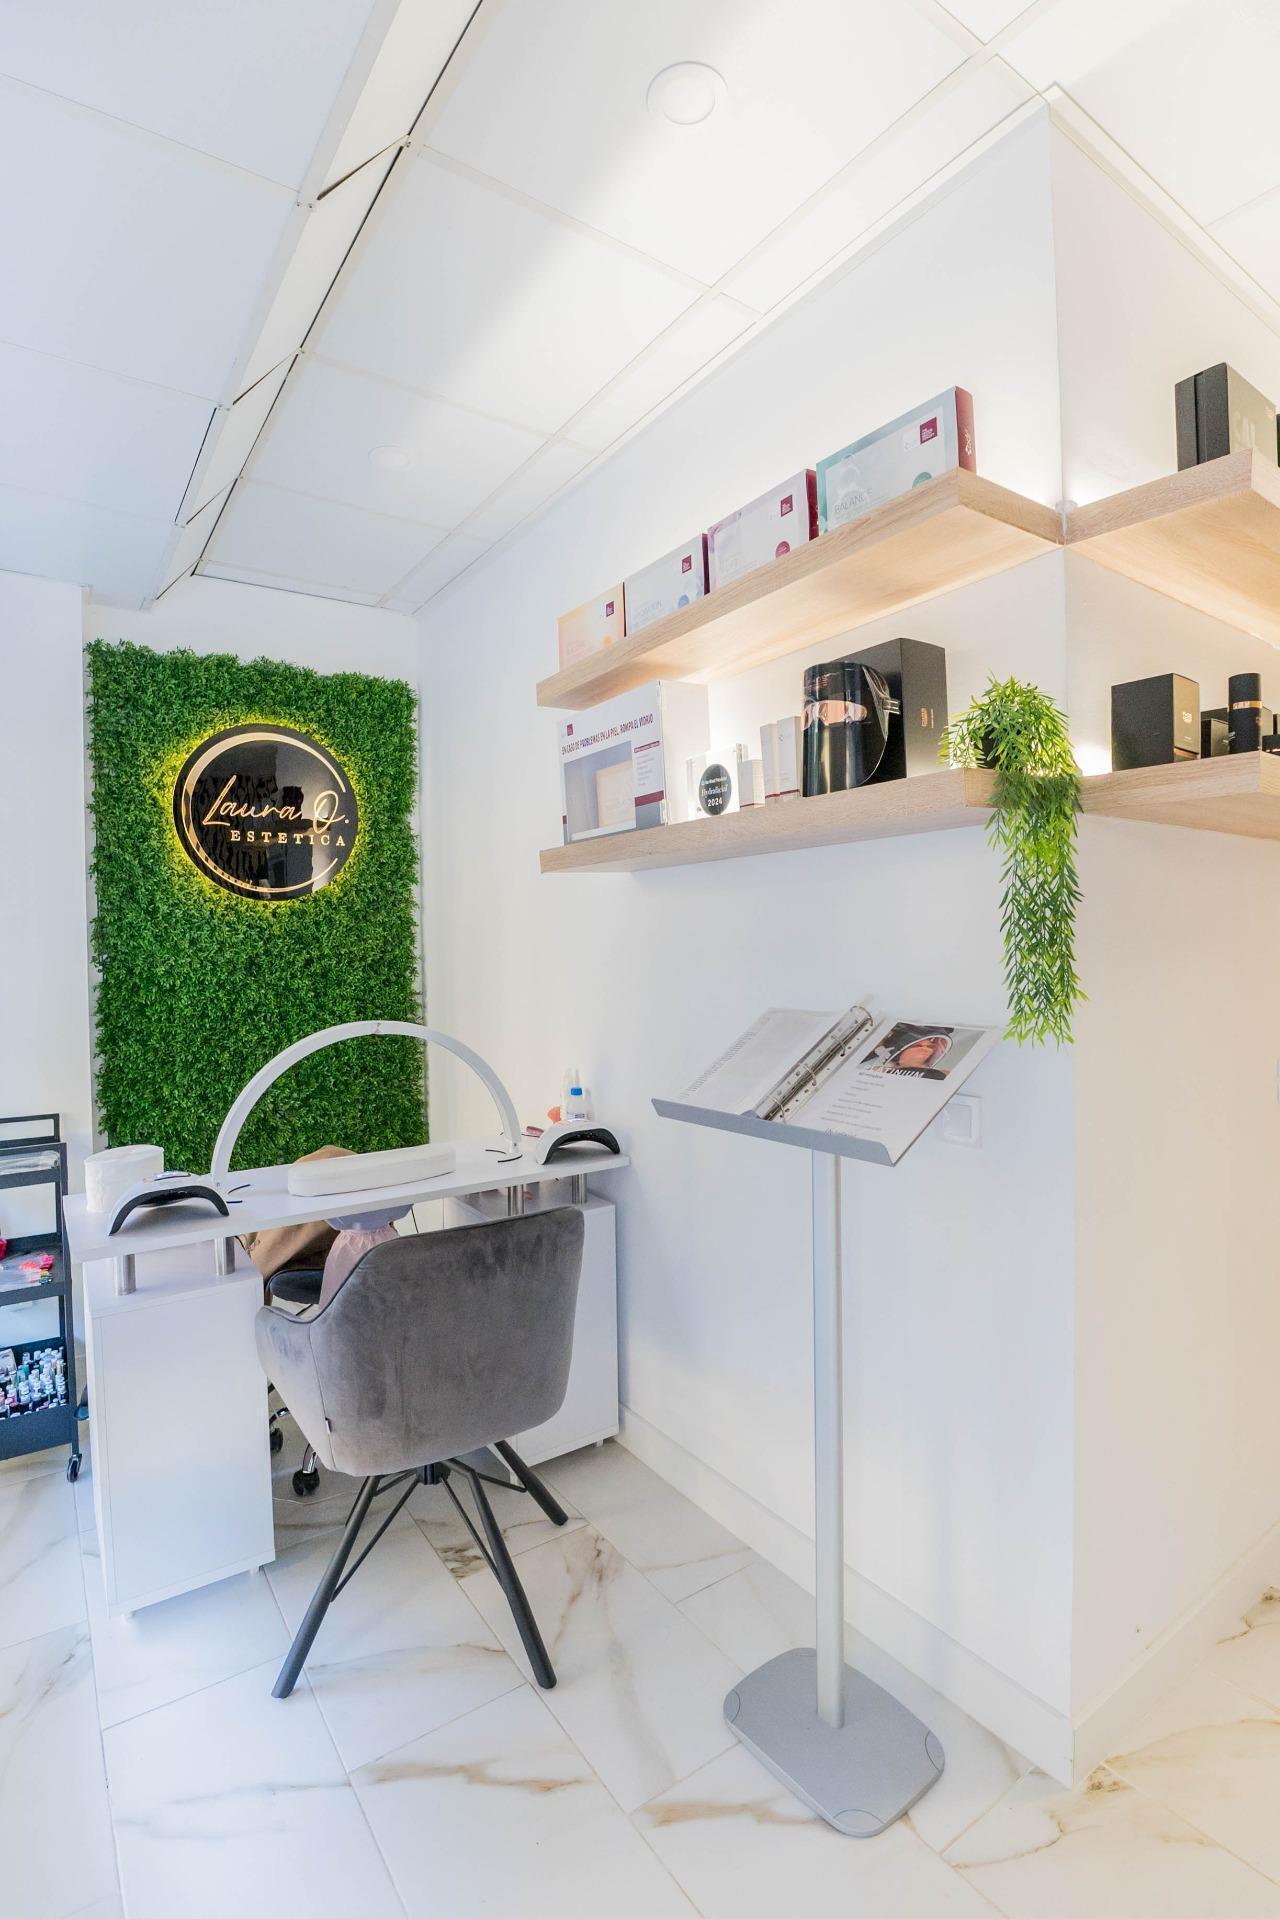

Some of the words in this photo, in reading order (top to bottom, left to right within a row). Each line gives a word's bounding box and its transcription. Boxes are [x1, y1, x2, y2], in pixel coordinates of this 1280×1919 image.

[202, 774, 302, 826] Laura
[708, 797, 723, 807] 2024
[230, 830, 346, 847] ESTETICA
